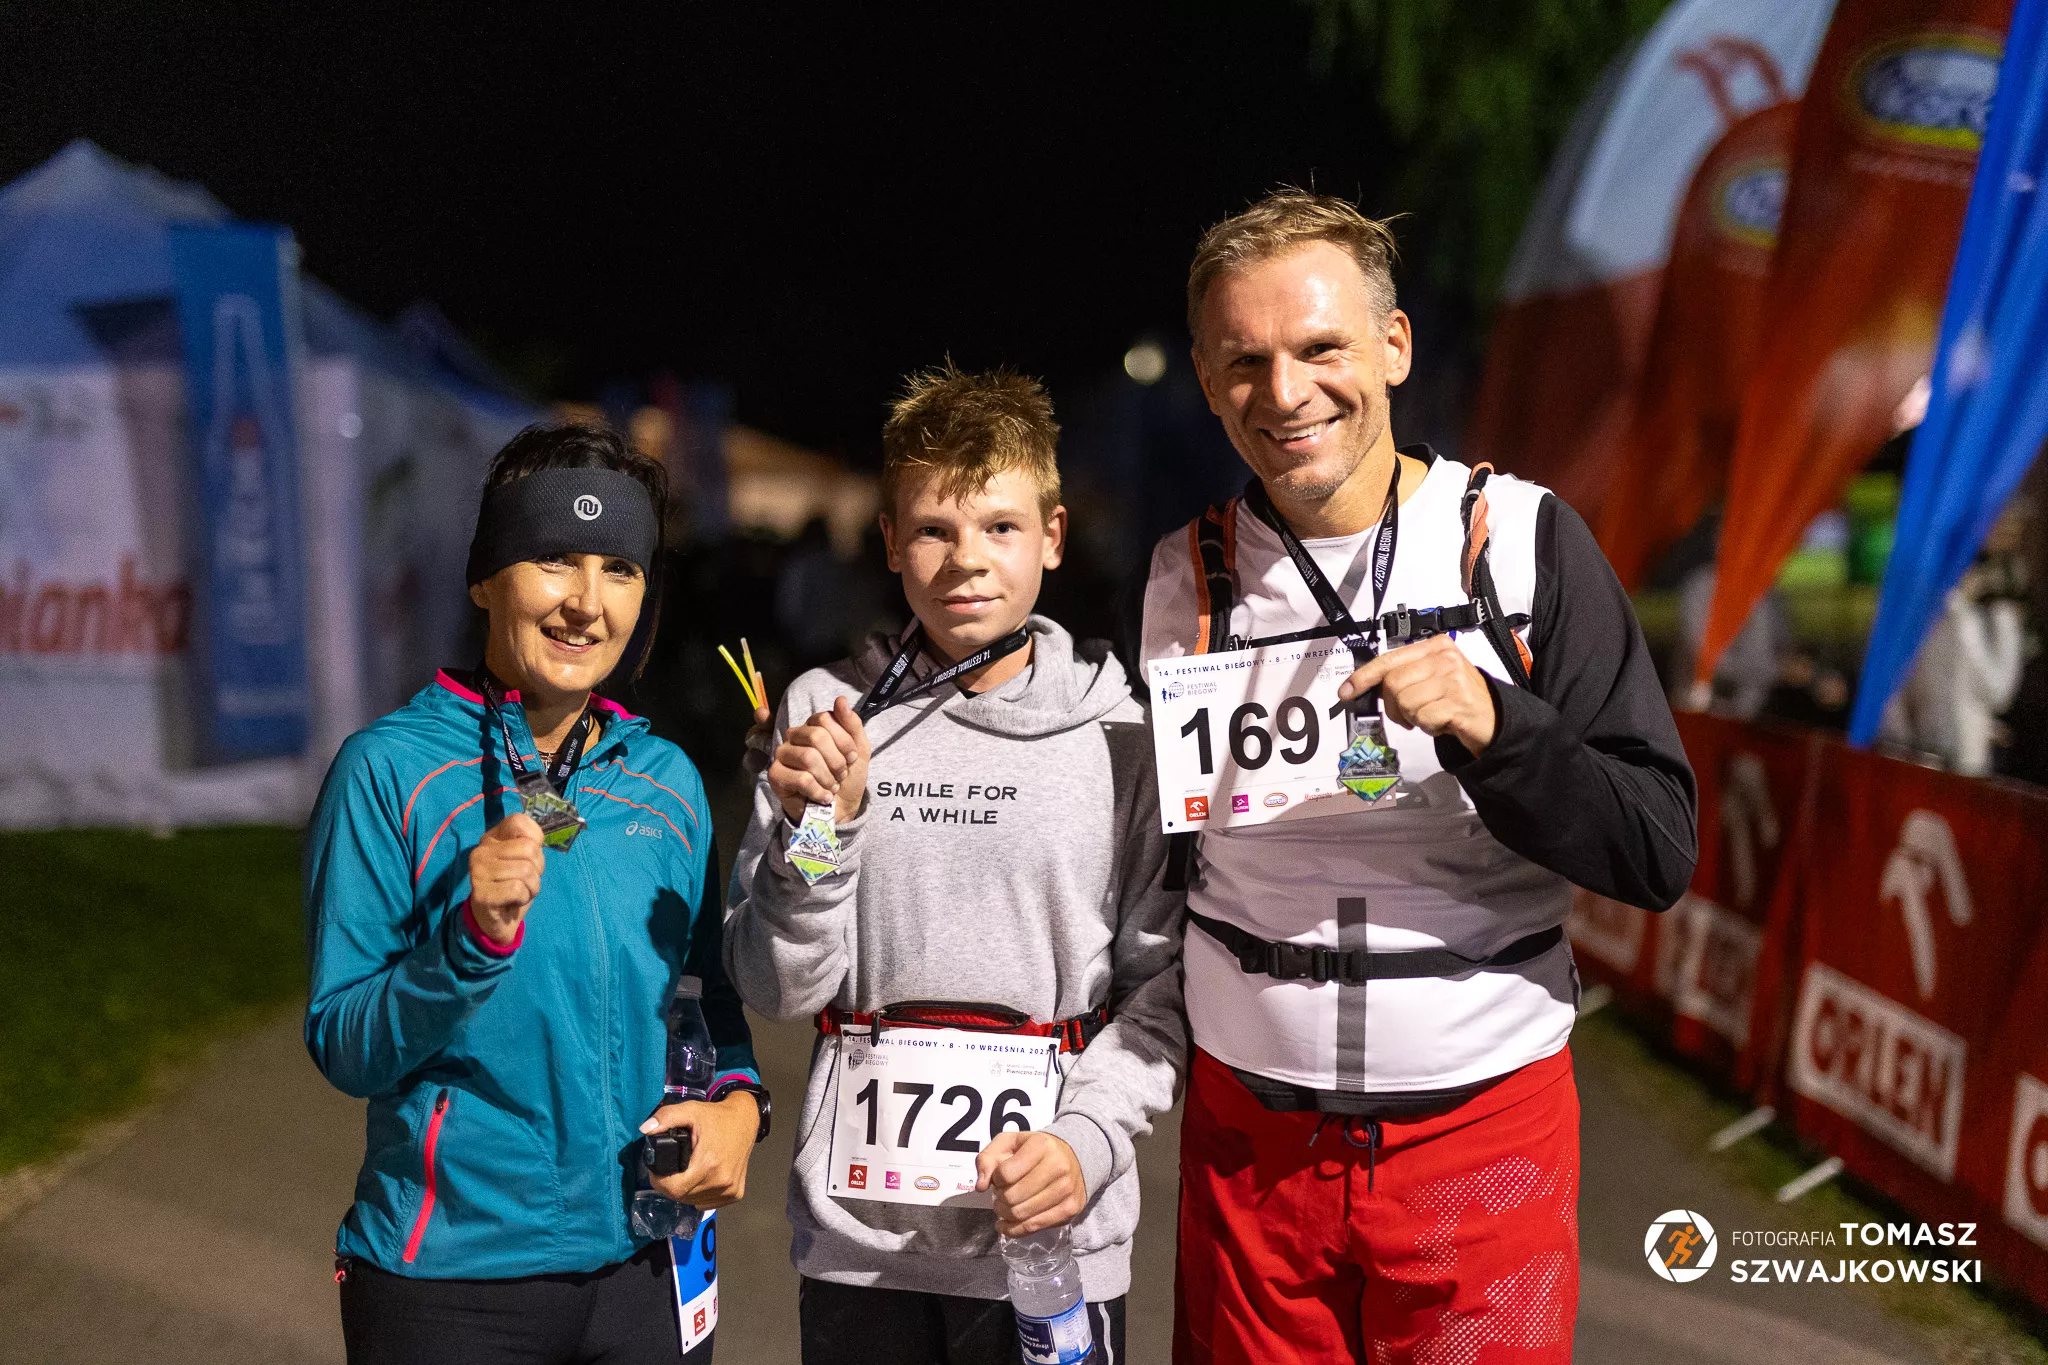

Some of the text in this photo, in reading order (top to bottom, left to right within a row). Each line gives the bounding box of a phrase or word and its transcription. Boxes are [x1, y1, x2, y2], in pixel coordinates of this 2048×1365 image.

[1375, 553, 1389, 582] FESTIWAL
[1176, 664, 1221, 675] FESTIWAL
[1225, 658, 1265, 669] BIEGOWY
[1304, 647, 1353, 659] WRZEŚNIA
[1187, 681, 1218, 690] FESTIWAL
[1187, 688, 1218, 696] BIEGOWY
[876, 781, 1018, 801] SMILE FOR
[890, 806, 998, 825] A WHILE
[638, 825, 663, 839] asics
[860, 1036, 895, 1045] FESWAL
[898, 1039, 938, 1048] BIEGOWY
[979, 1044, 1025, 1054] WRZEŚNIA
[856, 1079, 1032, 1153] 1726
